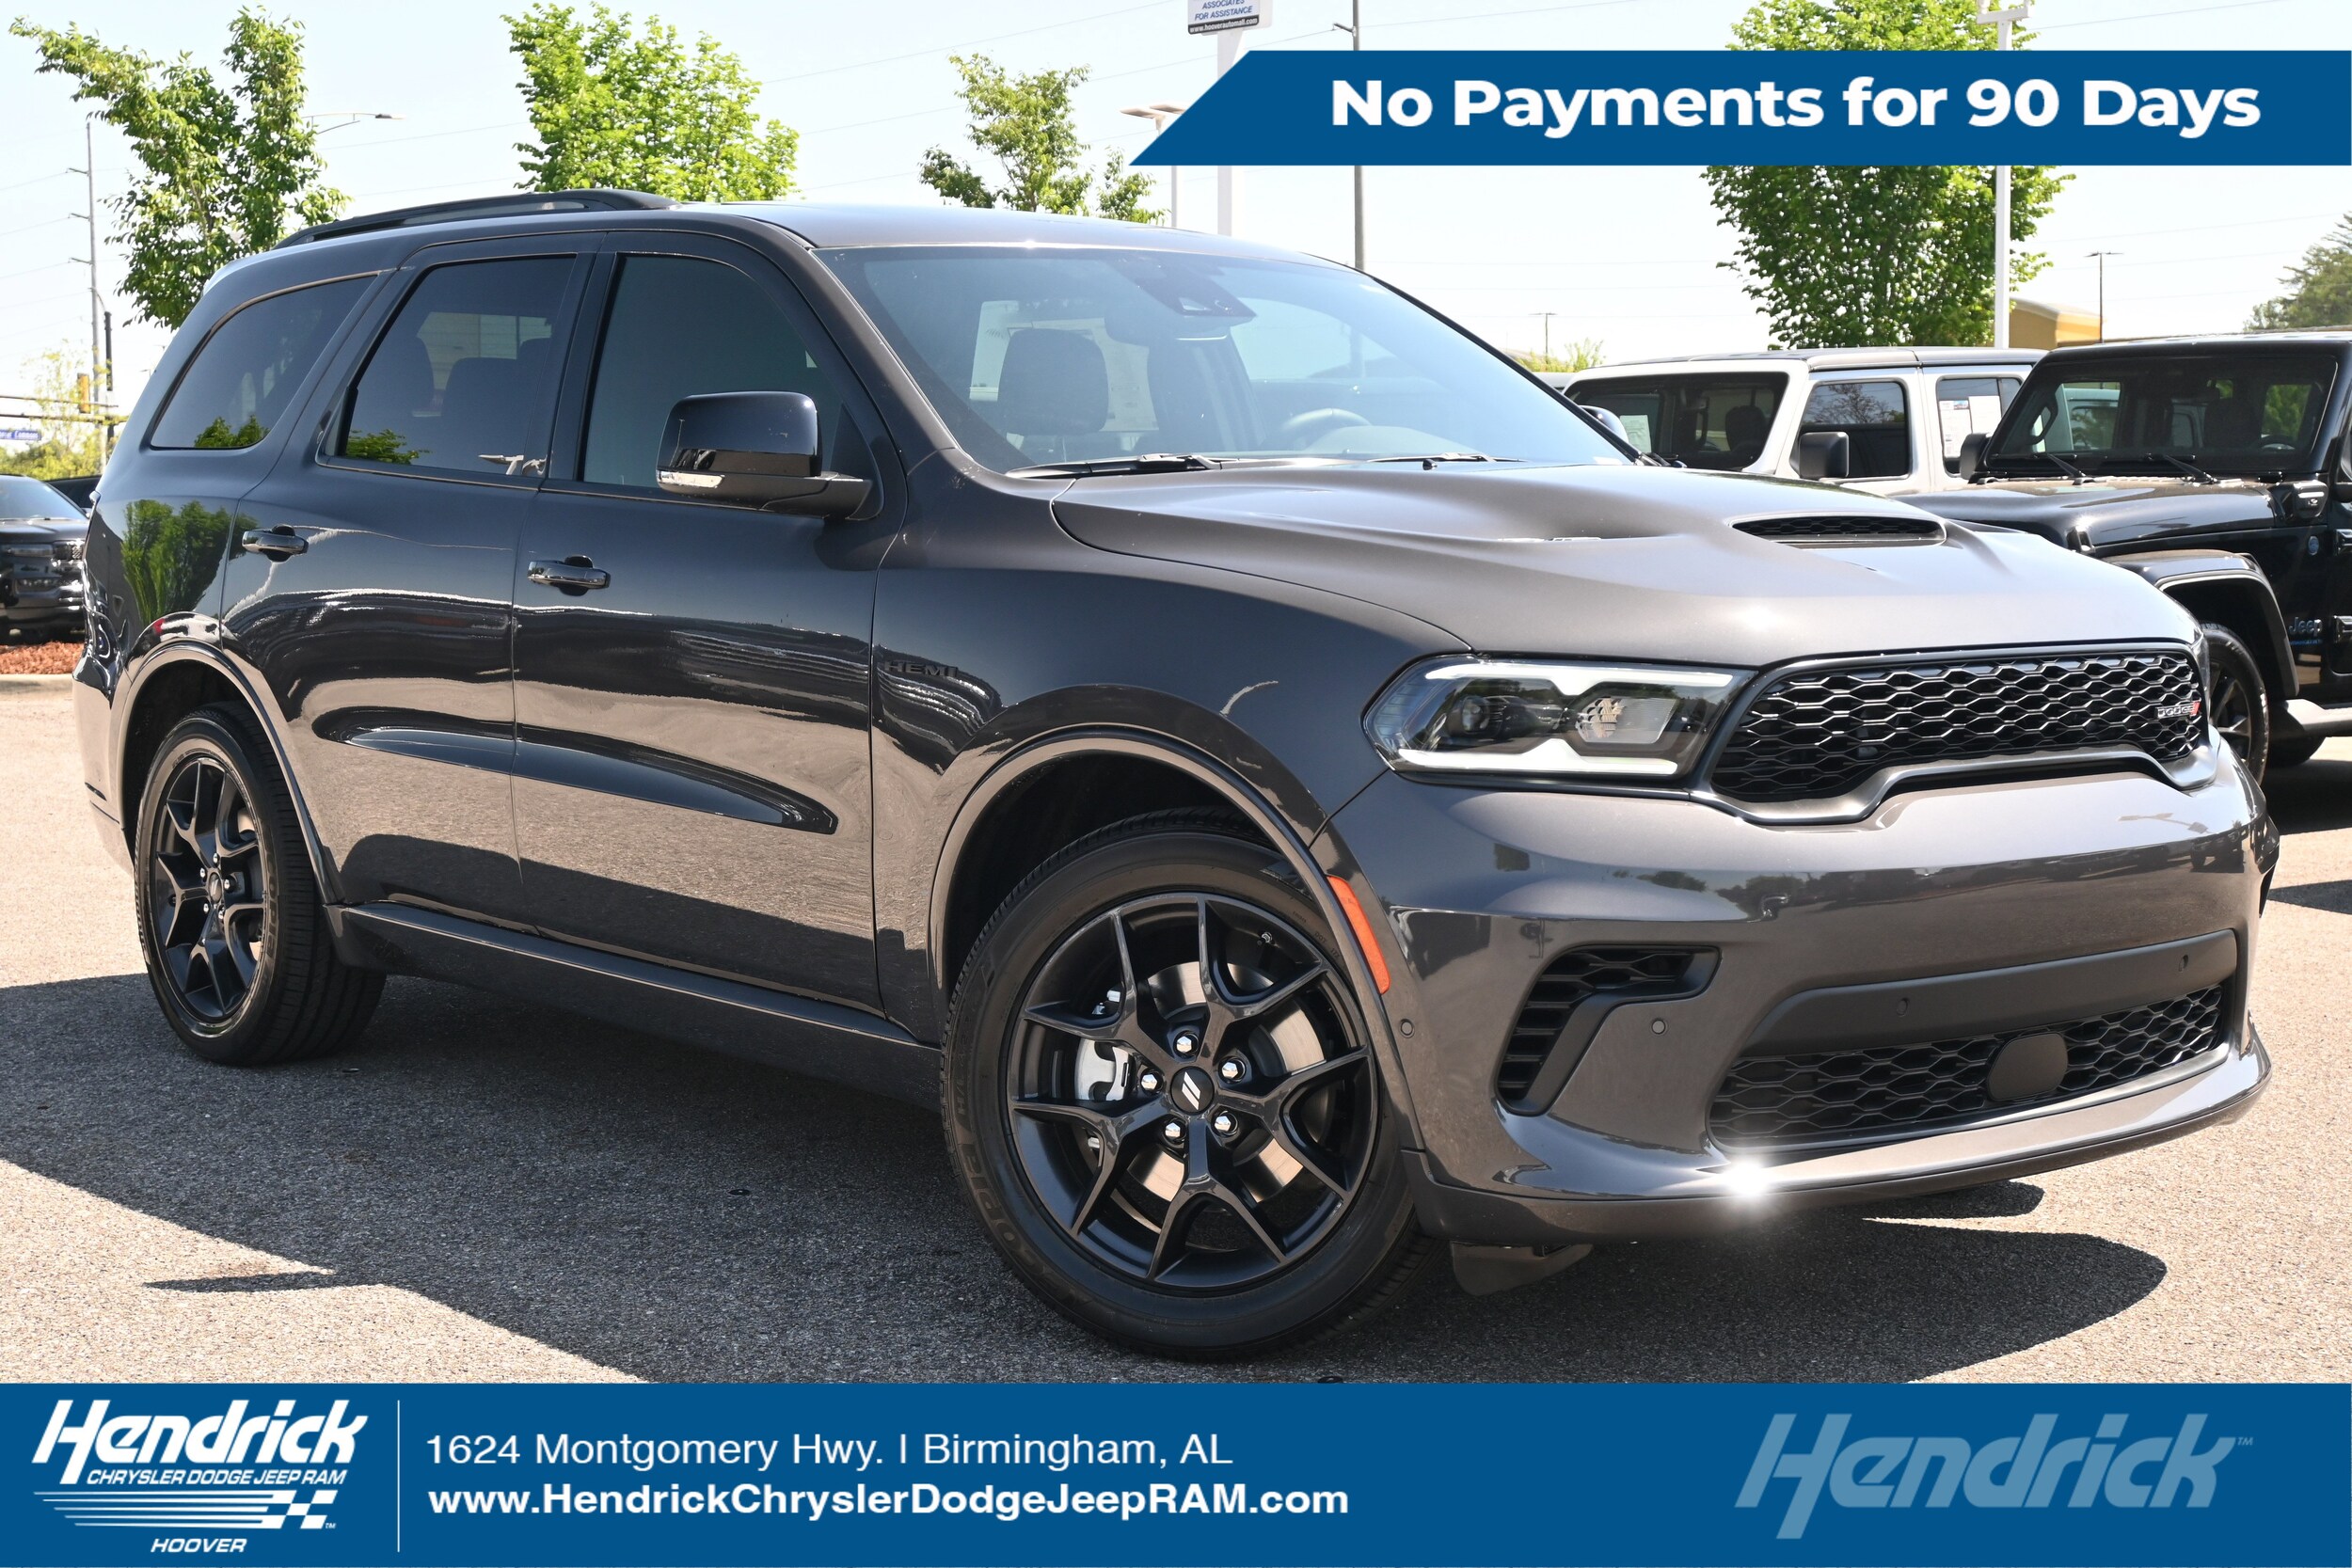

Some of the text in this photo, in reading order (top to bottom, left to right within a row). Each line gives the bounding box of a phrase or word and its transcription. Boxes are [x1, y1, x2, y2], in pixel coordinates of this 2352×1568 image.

[1202, 0, 1245, 9] ASSOCIATES
[1210, 6, 1252, 18] ASSISTANCE
[1189, 18, 1258, 33] www.hooverautomall.com
[2288, 616, 2323, 637] Jeep
[883, 660, 959, 677] HEMI
